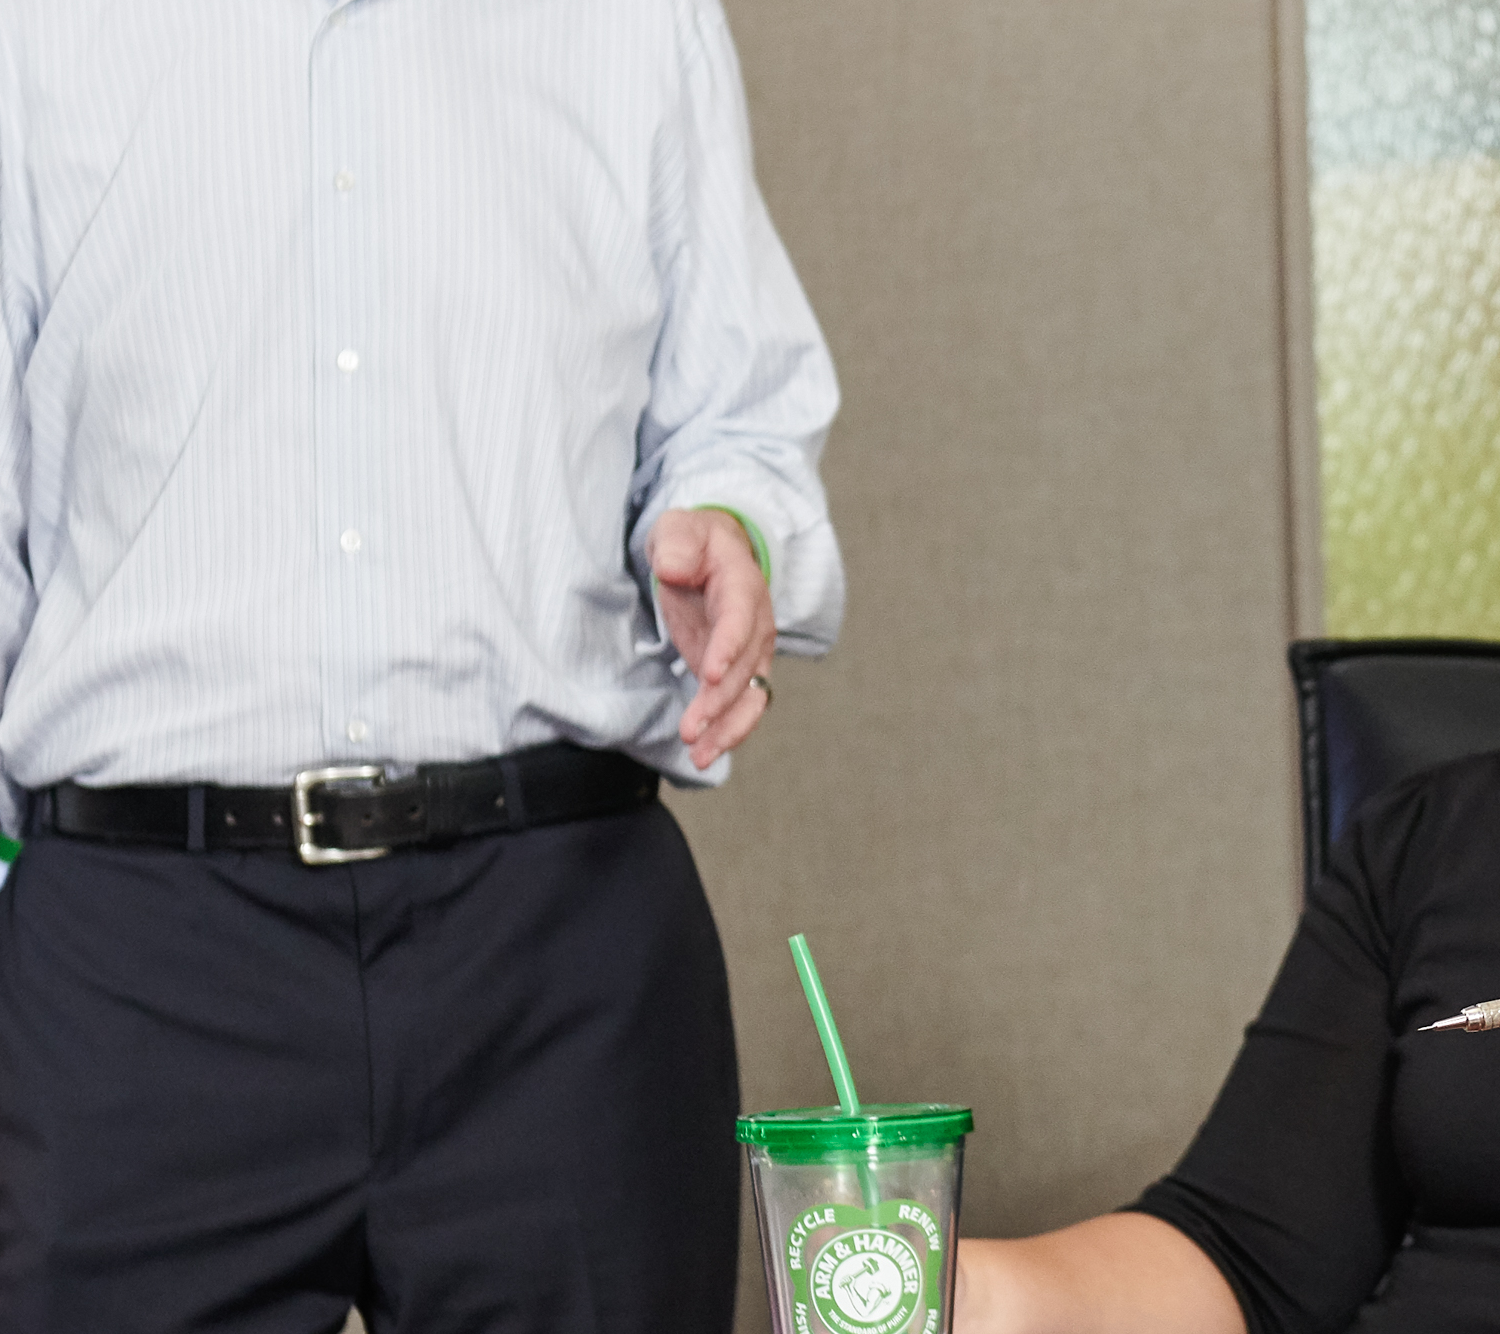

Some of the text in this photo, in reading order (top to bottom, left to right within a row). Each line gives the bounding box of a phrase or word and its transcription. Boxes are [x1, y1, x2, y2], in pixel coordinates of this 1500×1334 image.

[789, 1208, 836, 1270] RECYCLE
[898, 1204, 940, 1251] RENEW
[815, 1233, 919, 1300] ARM & HAMMER
[828, 1308, 840, 1325] THE
[877, 1323, 887, 1334] OF
